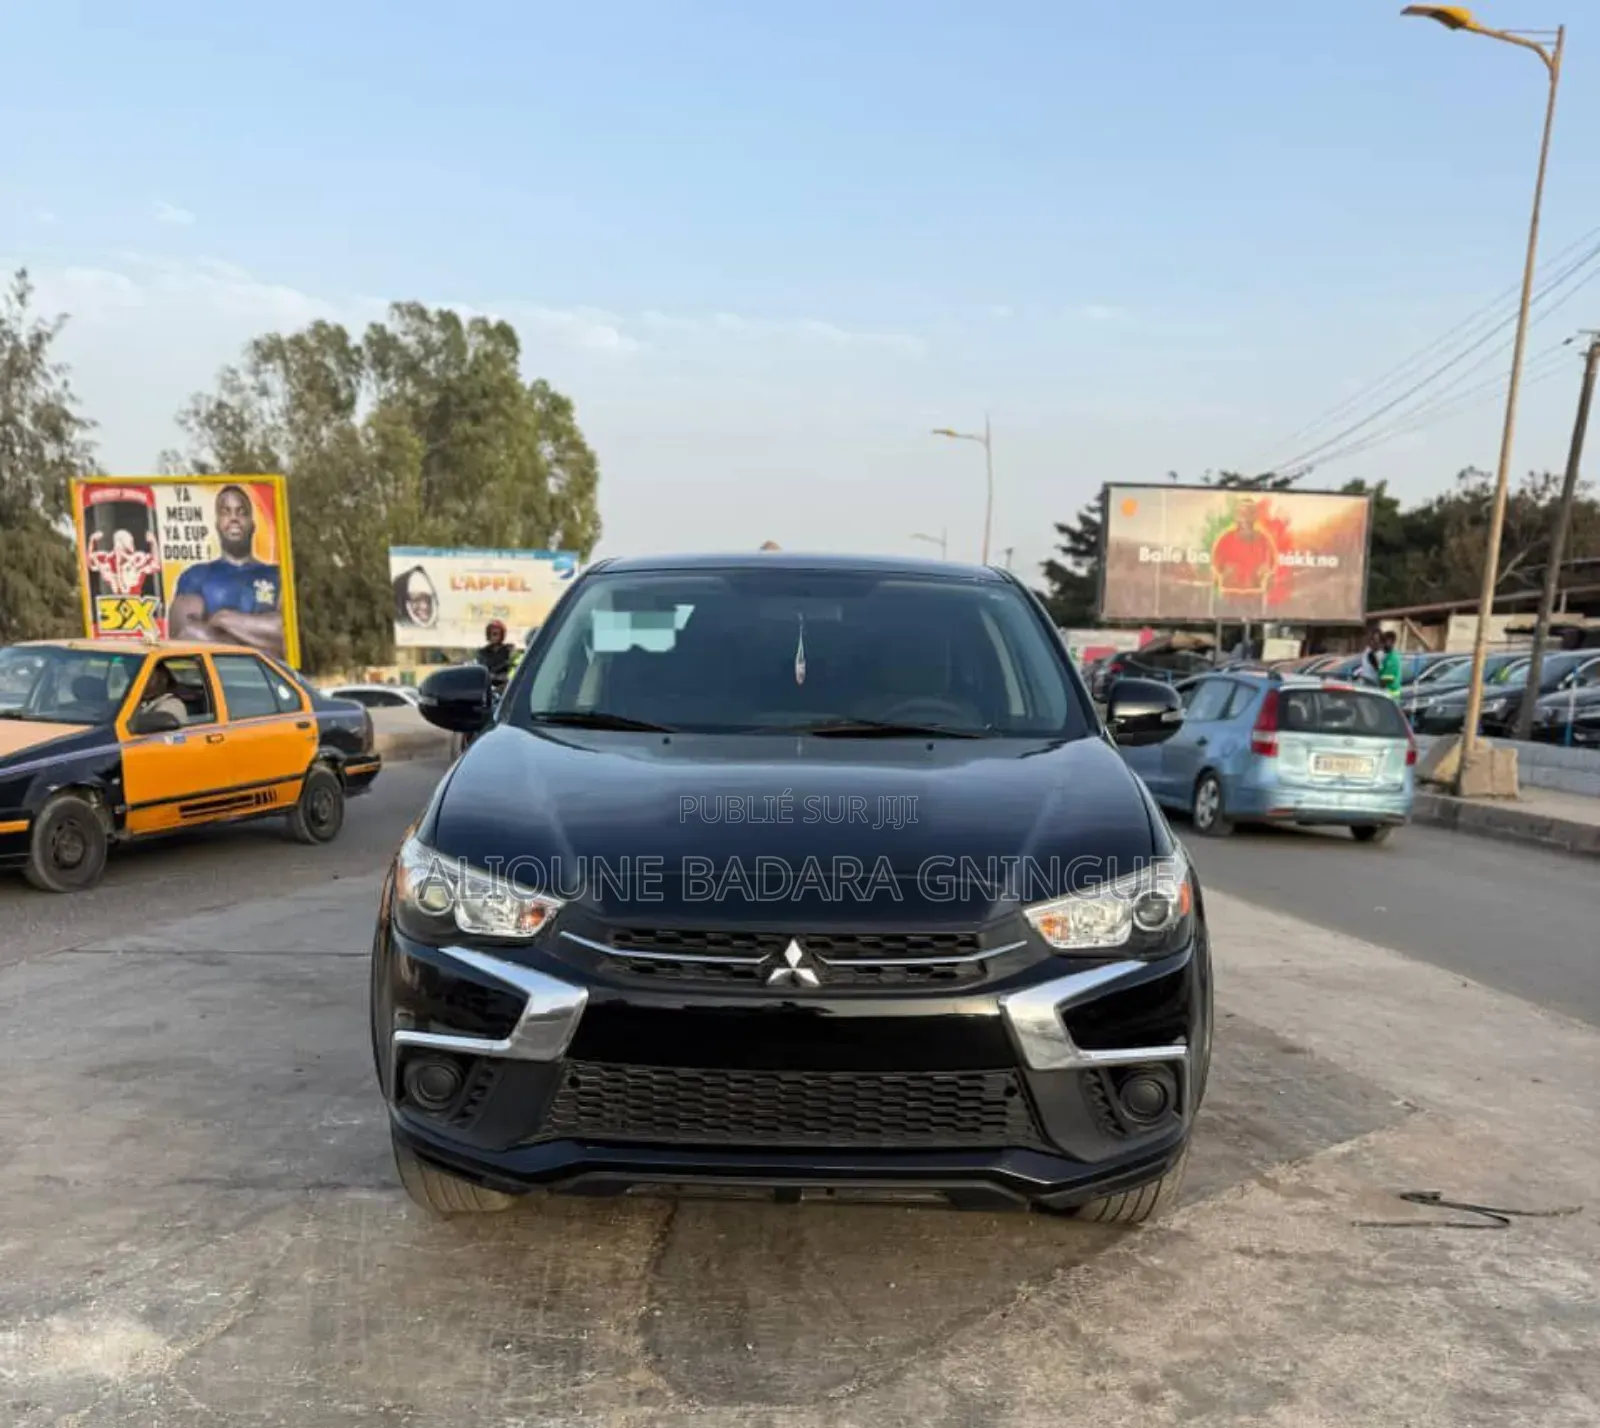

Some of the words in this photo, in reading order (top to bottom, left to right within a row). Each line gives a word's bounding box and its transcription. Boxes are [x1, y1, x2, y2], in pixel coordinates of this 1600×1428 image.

[173, 486, 192, 502] YA
[166, 506, 203, 521] MEUN
[164, 526, 180, 541] YA
